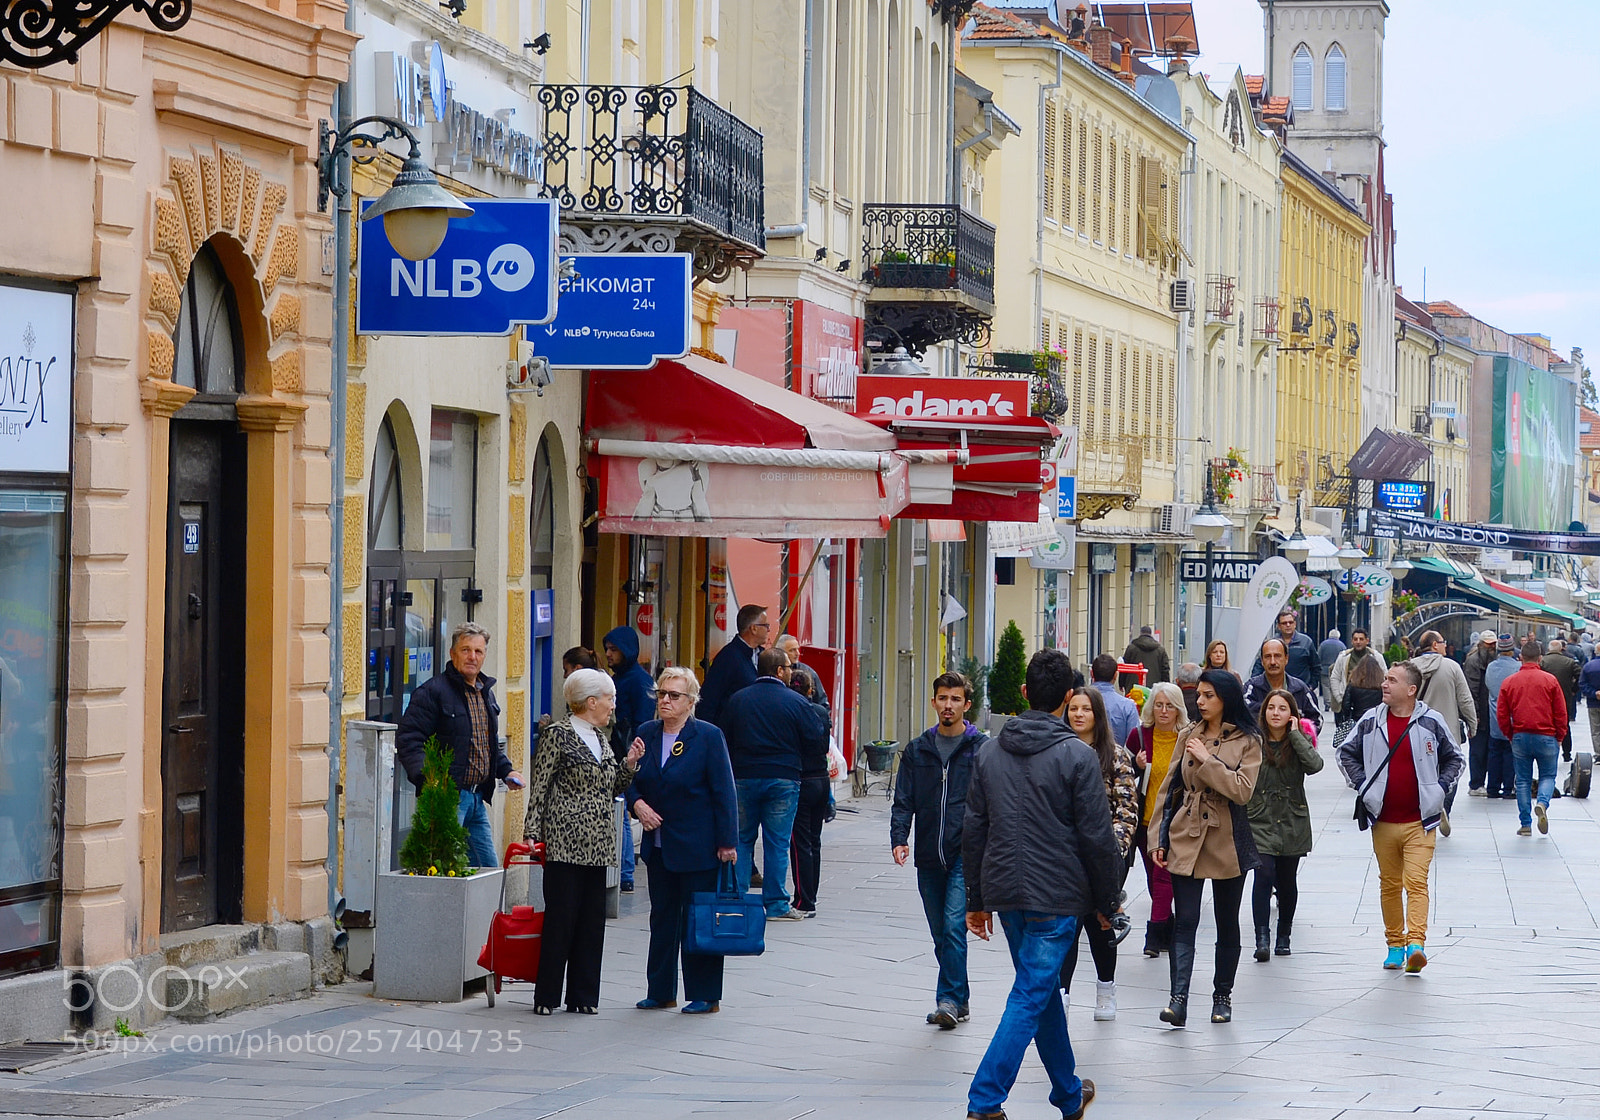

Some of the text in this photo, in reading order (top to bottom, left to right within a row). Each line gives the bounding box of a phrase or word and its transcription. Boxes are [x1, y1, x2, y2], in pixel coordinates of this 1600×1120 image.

[390, 259, 482, 298] NLB
[559, 277, 655, 293] анкомат
[632, 298, 655, 310] 24ч
[564, 329, 655, 339] NLB Тутунска банка
[870, 391, 1014, 417] adam's
[760, 471, 863, 483] СОВРШЕНИ ЗАЕДНО
[186, 525, 197, 543] 43
[1403, 522, 1456, 541] JAMES
[1461, 527, 1509, 546] BOND
